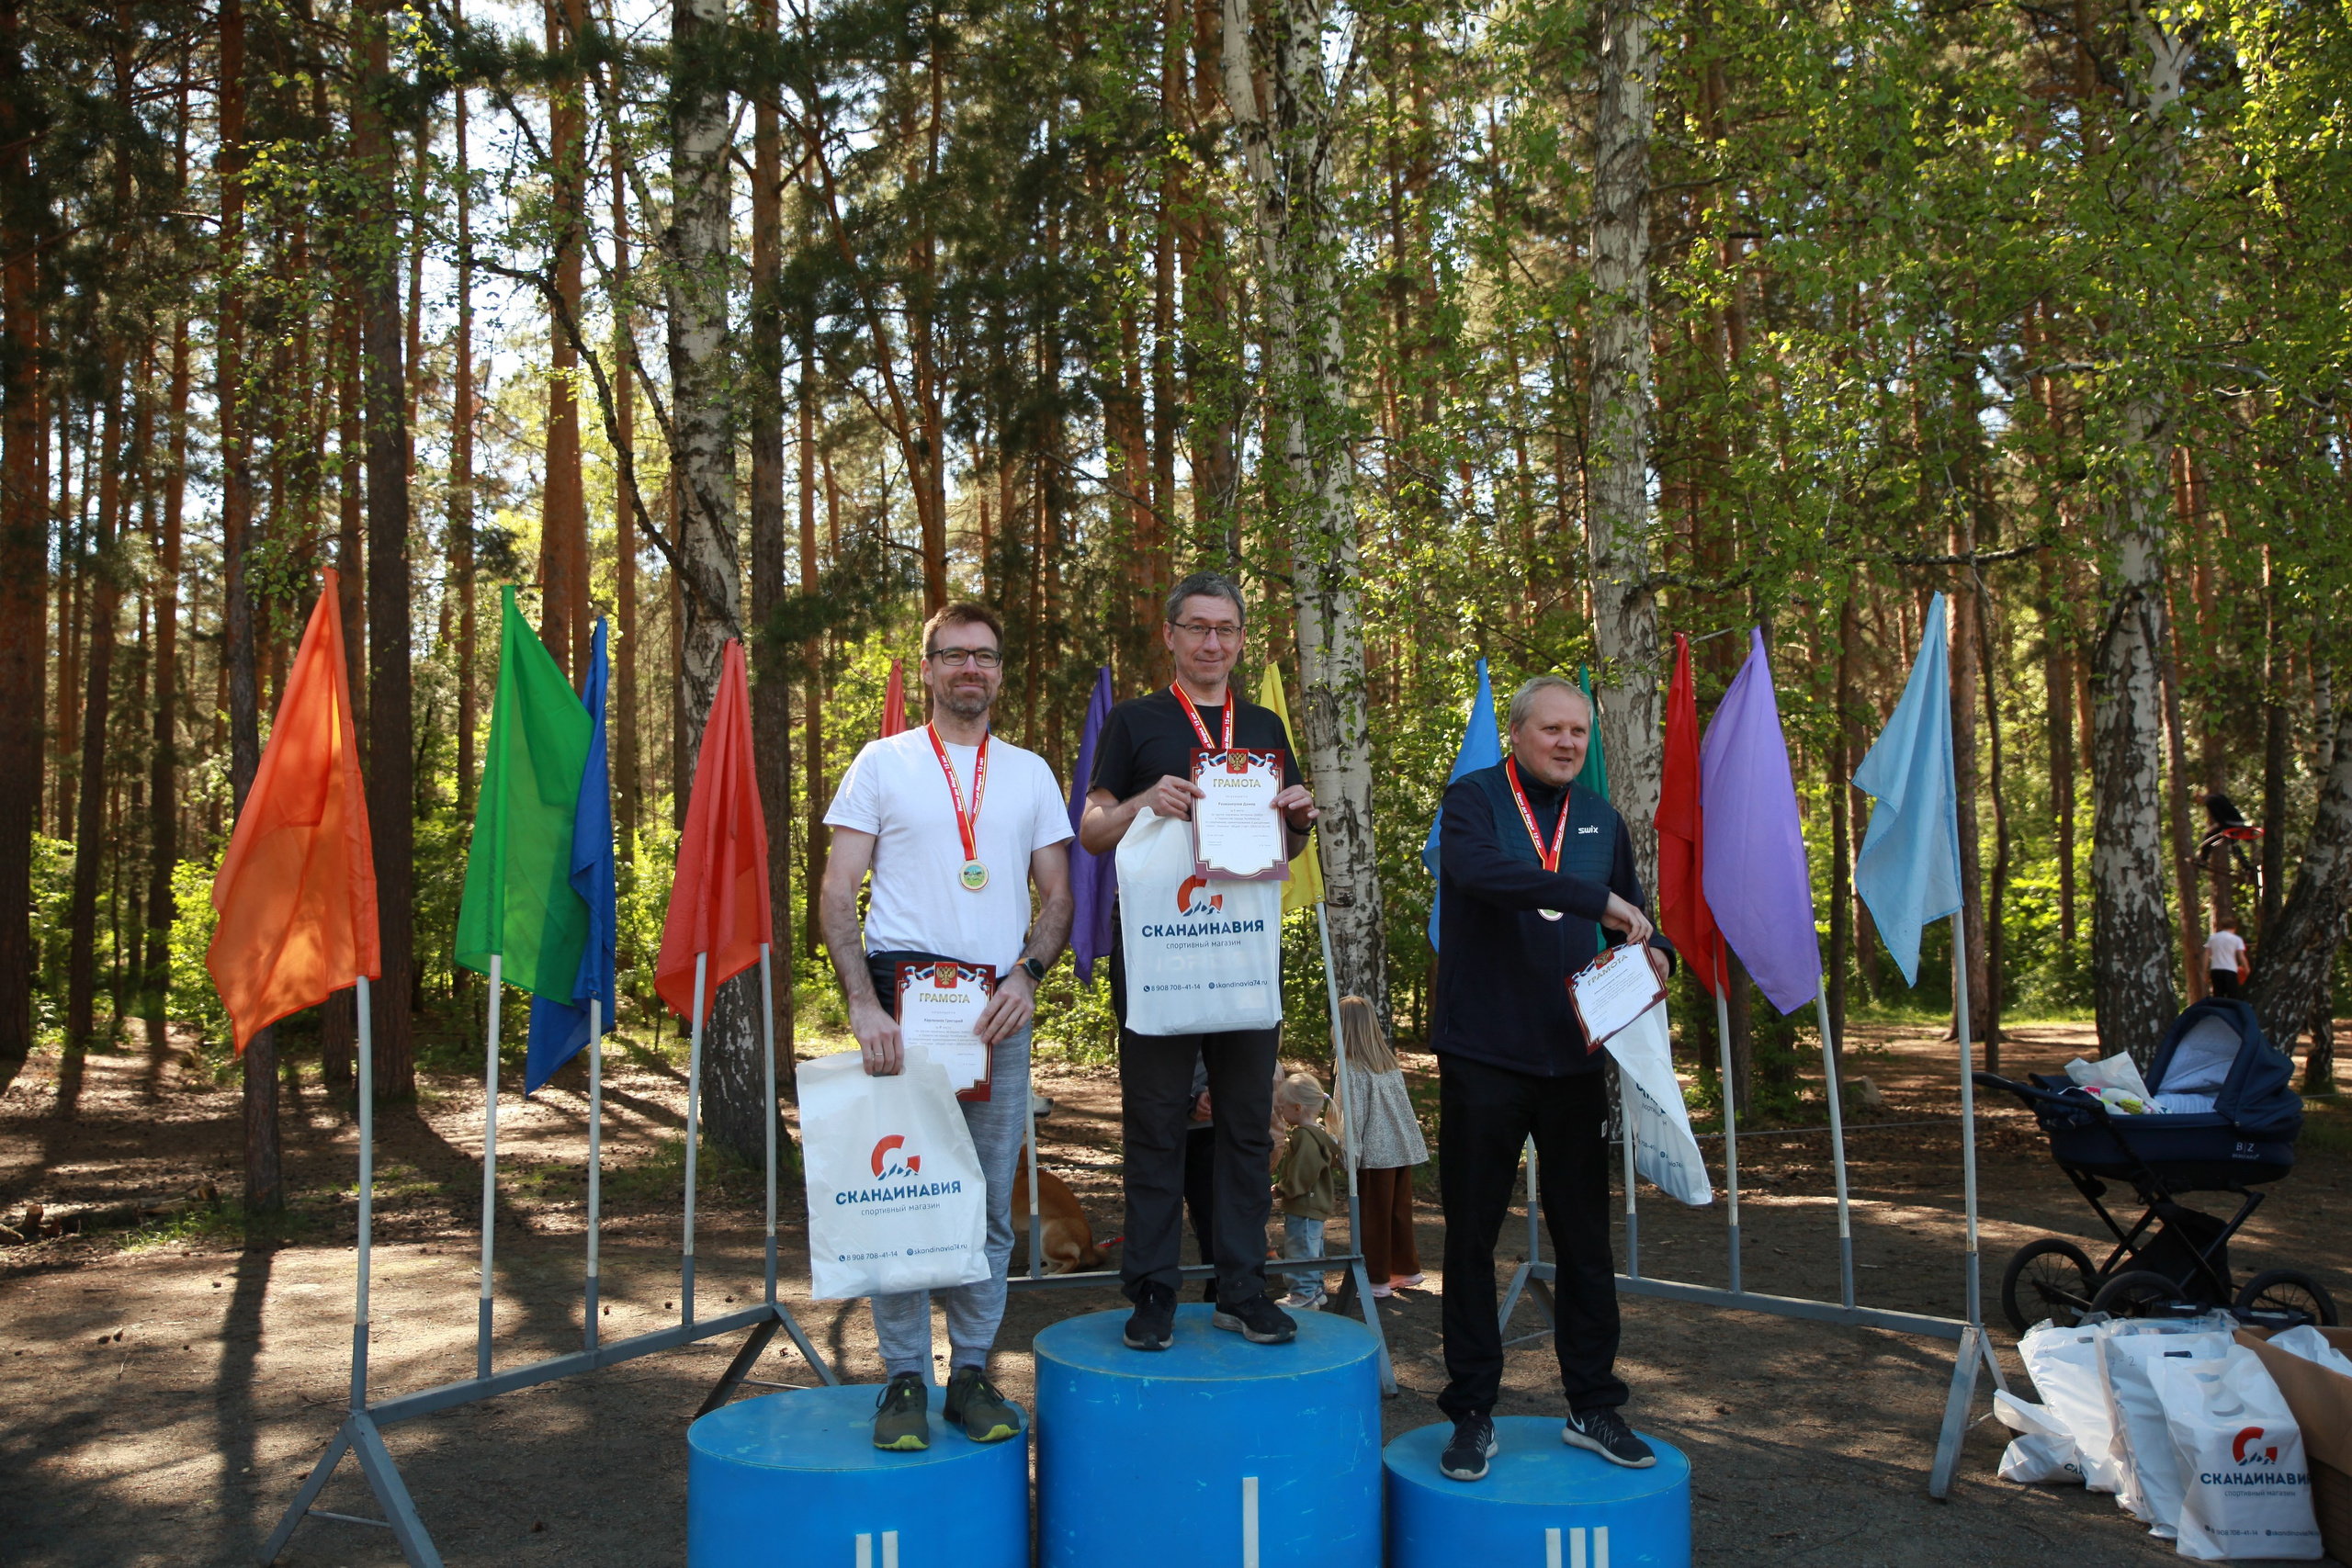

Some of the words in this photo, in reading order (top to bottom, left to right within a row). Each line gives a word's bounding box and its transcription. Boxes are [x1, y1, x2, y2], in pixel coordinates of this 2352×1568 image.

[948, 771, 956, 788] Марья
[1213, 778, 1261, 788] ГРАМОТА
[1525, 813, 1535, 830] Марья
[1141, 919, 1264, 938] СКАНДИНАВИЯ
[1166, 940, 1210, 951] спортивный
[1211, 939, 1241, 948] магазин
[1588, 954, 1628, 986] ГРАМОТА
[1215, 979, 1268, 988] skandinavia74.ru
[919, 992, 970, 1003] ГРАМОТА
[835, 1180, 962, 1205] СКАНДИНАВИЯ
[861, 1204, 907, 1216] спортивный
[909, 1201, 941, 1211] магазин
[865, 1251, 899, 1260] 708-41-14
[914, 1244, 967, 1256] skandinavia74.ru
[2224, 1490, 2266, 1498] спортивный
